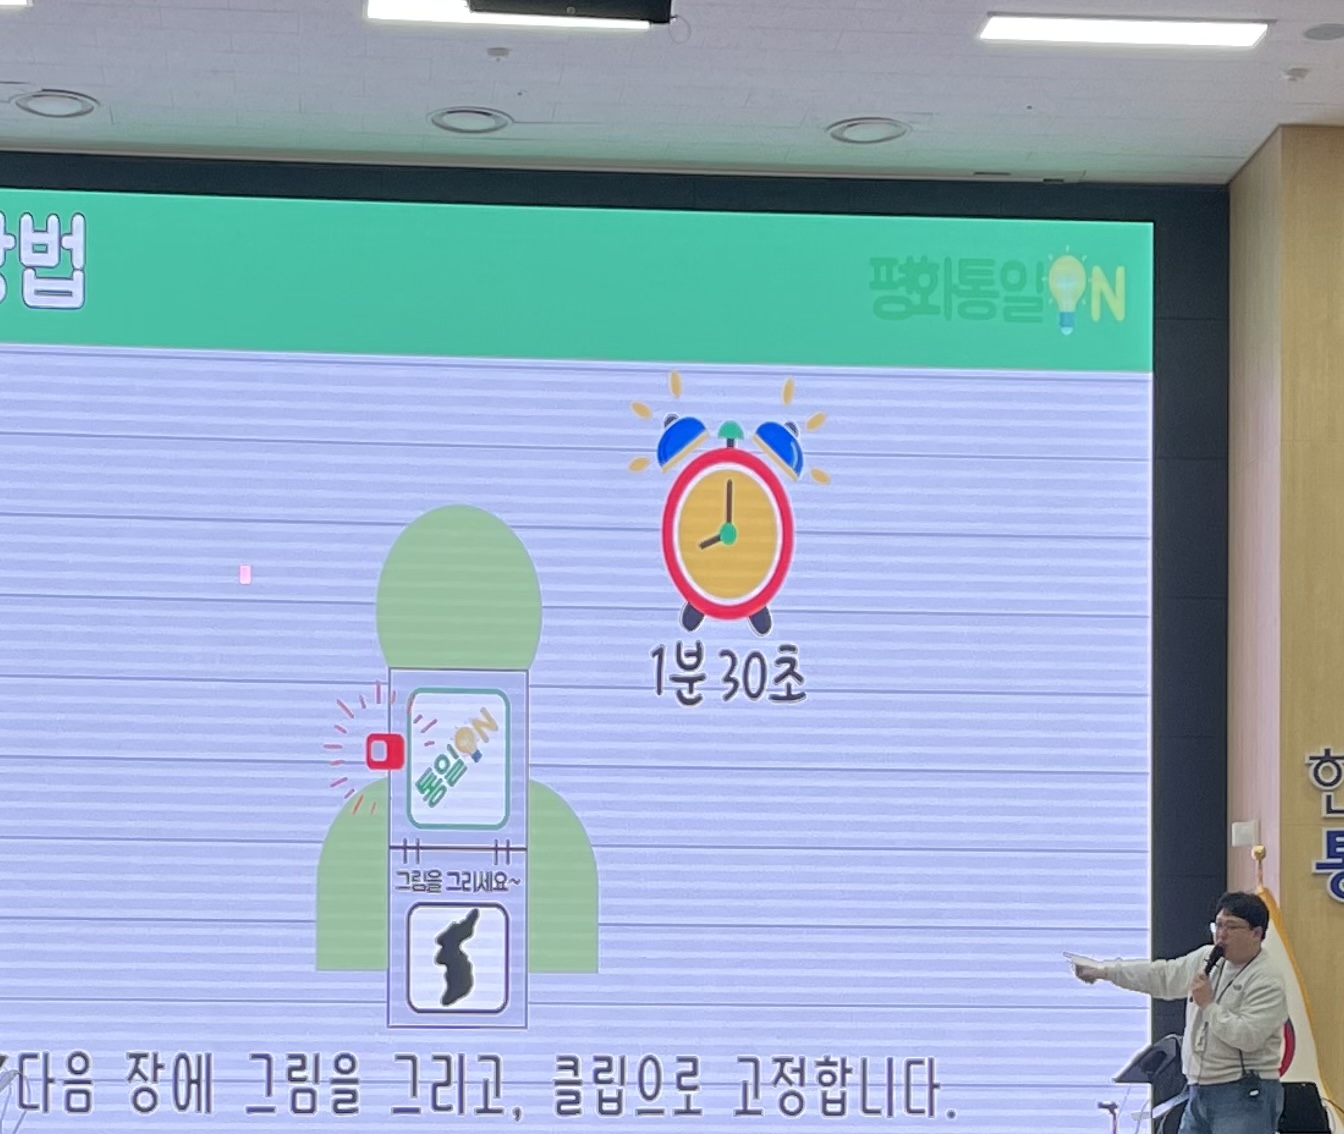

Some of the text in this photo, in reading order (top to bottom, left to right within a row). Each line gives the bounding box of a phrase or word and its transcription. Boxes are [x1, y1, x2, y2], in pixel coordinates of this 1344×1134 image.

[650, 640, 806, 706] 1분 30초
[395, 869, 521, 894] 그림을 그리세요~
[18, 1052, 956, 1121] 다음 장에 그림을 그리고, 클립으로 고정합니다.
